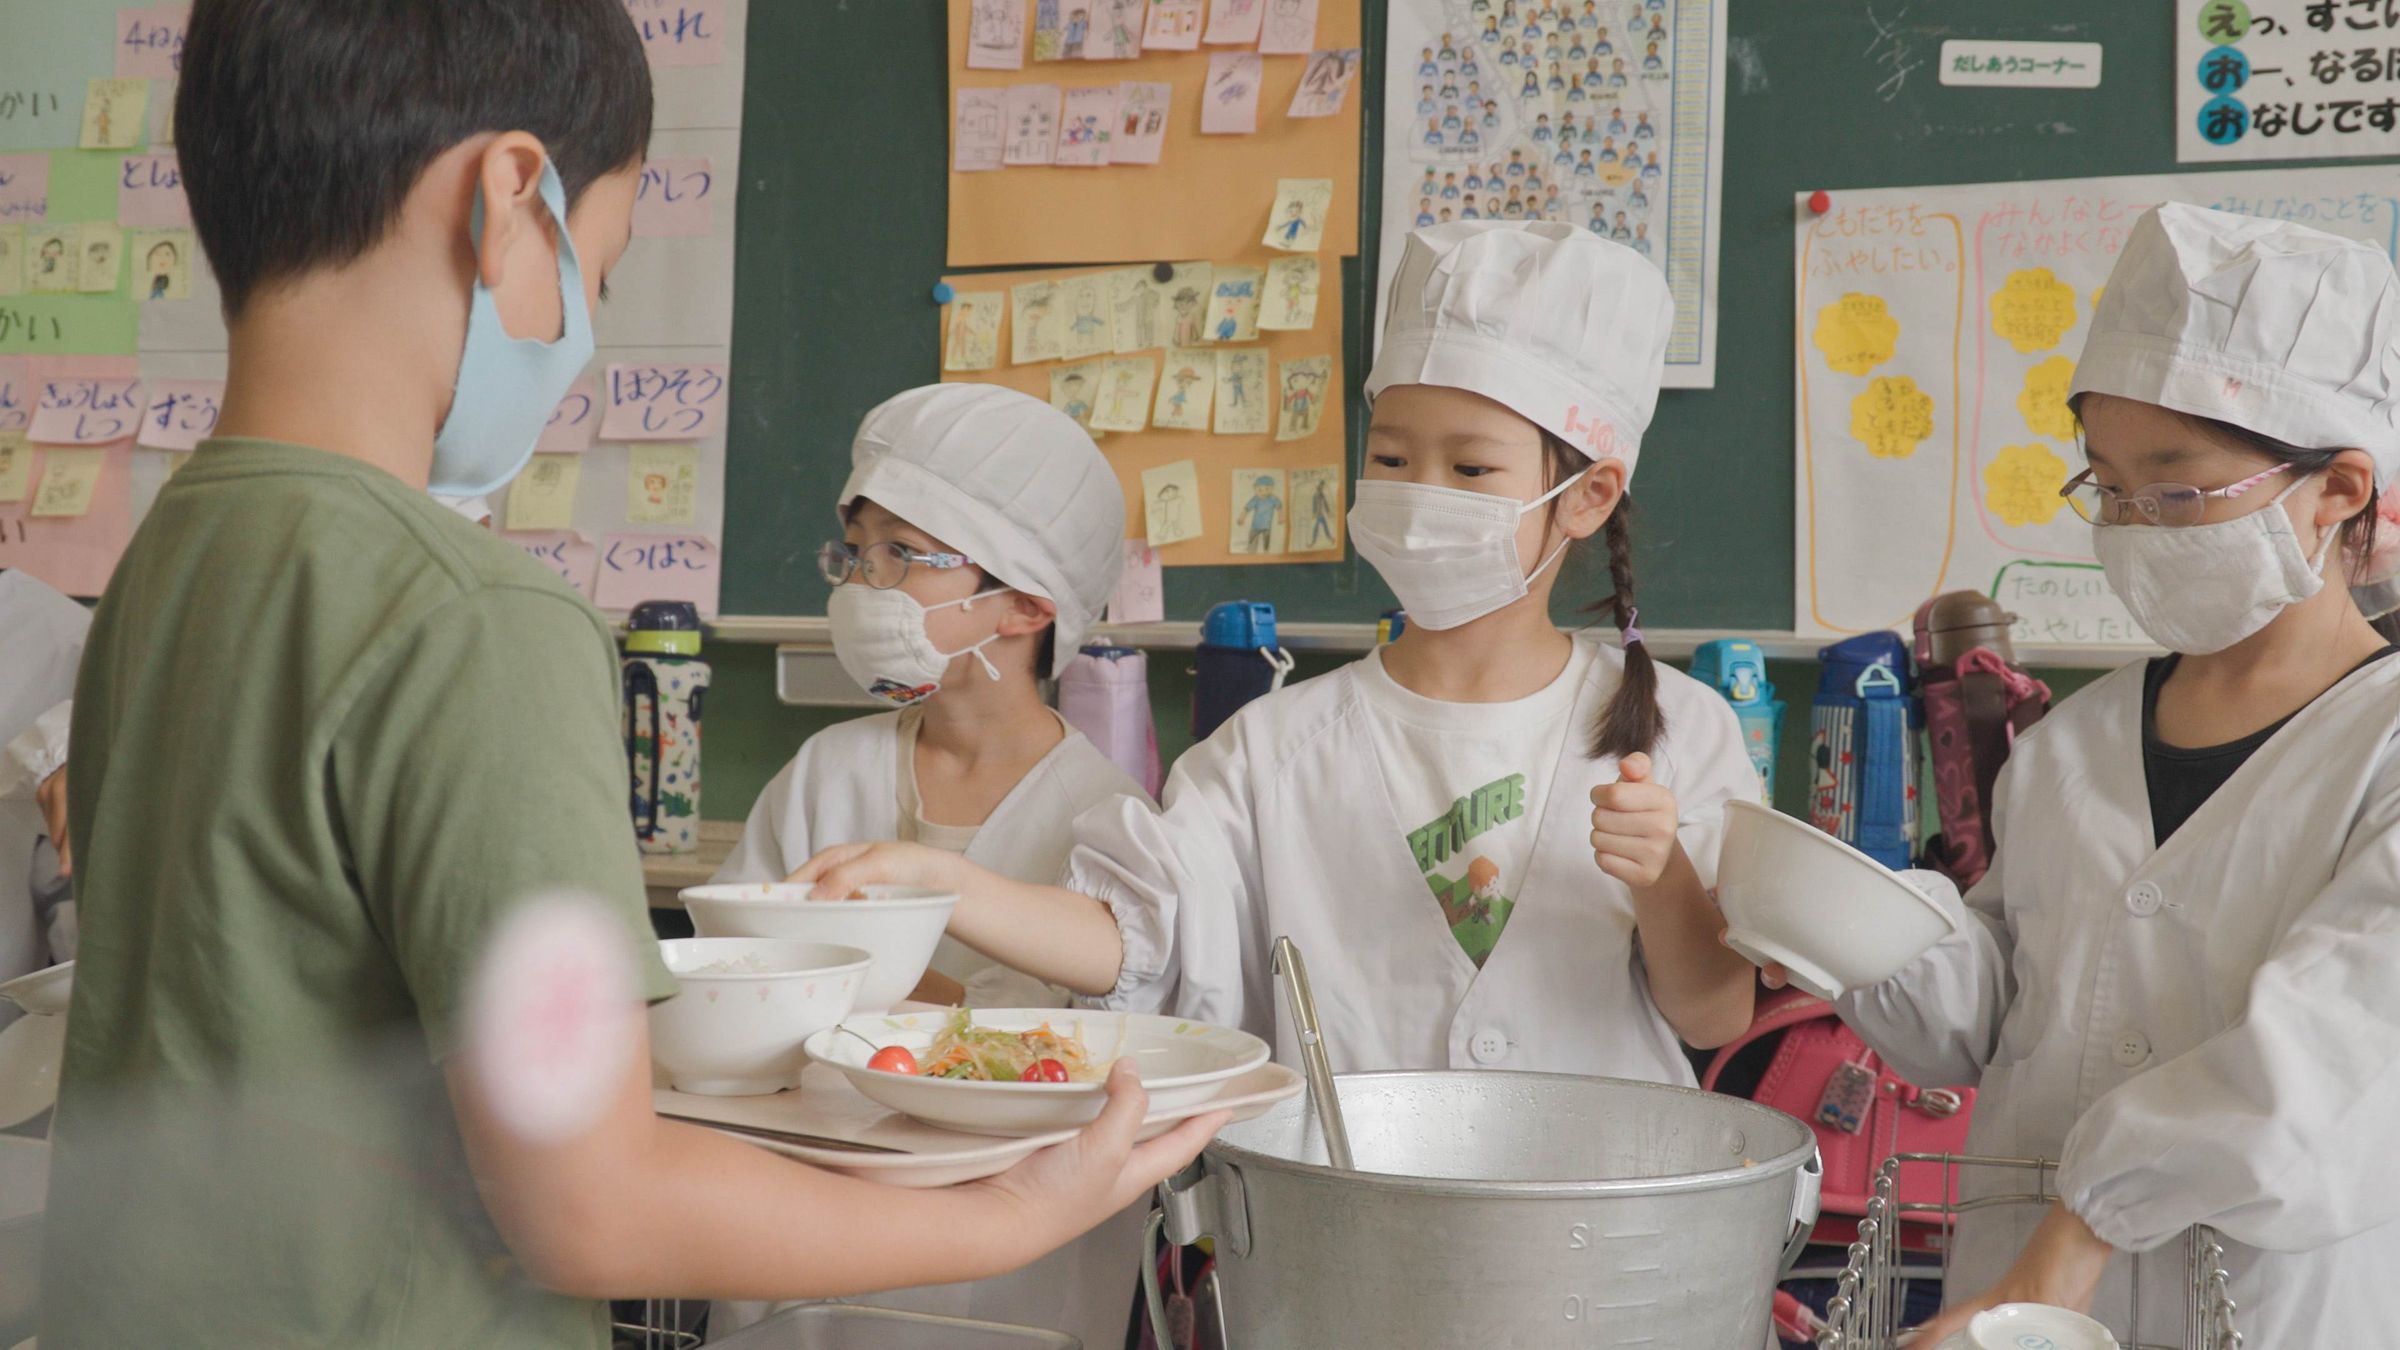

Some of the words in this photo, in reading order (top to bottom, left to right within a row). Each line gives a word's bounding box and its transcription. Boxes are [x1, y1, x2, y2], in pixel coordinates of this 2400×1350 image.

[1952, 54, 2086, 74] だしあうコーナー
[1998, 226, 2133, 258] なかよくな
[611, 367, 723, 406] ほうそう
[642, 406, 704, 432] しつ
[605, 540, 708, 571] くつばこ
[2011, 576, 2118, 600] たのしい
